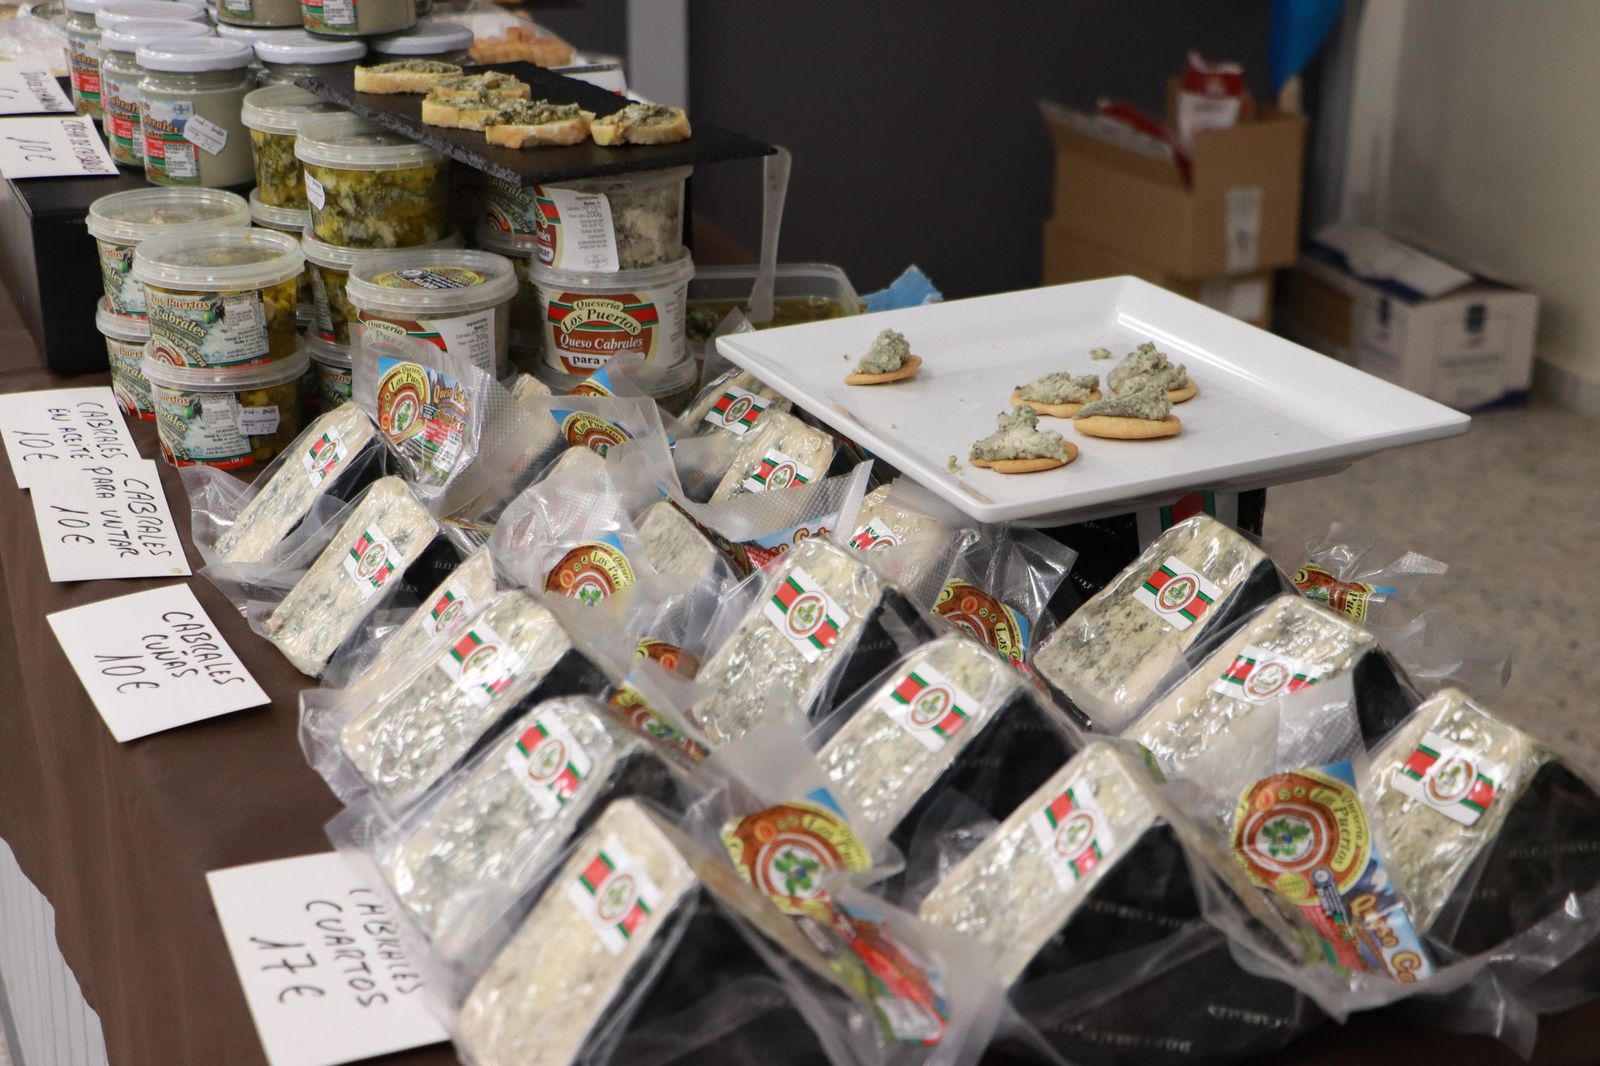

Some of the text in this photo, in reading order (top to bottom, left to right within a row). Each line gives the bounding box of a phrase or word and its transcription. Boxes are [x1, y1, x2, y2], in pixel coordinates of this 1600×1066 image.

[143, 113, 180, 134] abrales
[156, 304, 208, 339] Cabrales
[167, 297, 211, 311] Puertos
[562, 308, 640, 334] Los Puertos
[187, 346, 208, 367] Extra
[560, 333, 645, 351] Queso Cabrales
[572, 355, 601, 366] para
[47, 408, 95, 461] EN ACEITE
[76, 402, 129, 460] CABRALES
[81, 466, 140, 559] PARA UNTAR
[122, 477, 173, 558] CABRALES
[592, 551, 609, 567] Los
[162, 611, 246, 687] CABRALES
[994, 623, 1009, 653] Los
[141, 633, 199, 680] CUÑAS
[1332, 804, 1351, 867] Puertos
[305, 899, 389, 1008] CUARTOS
